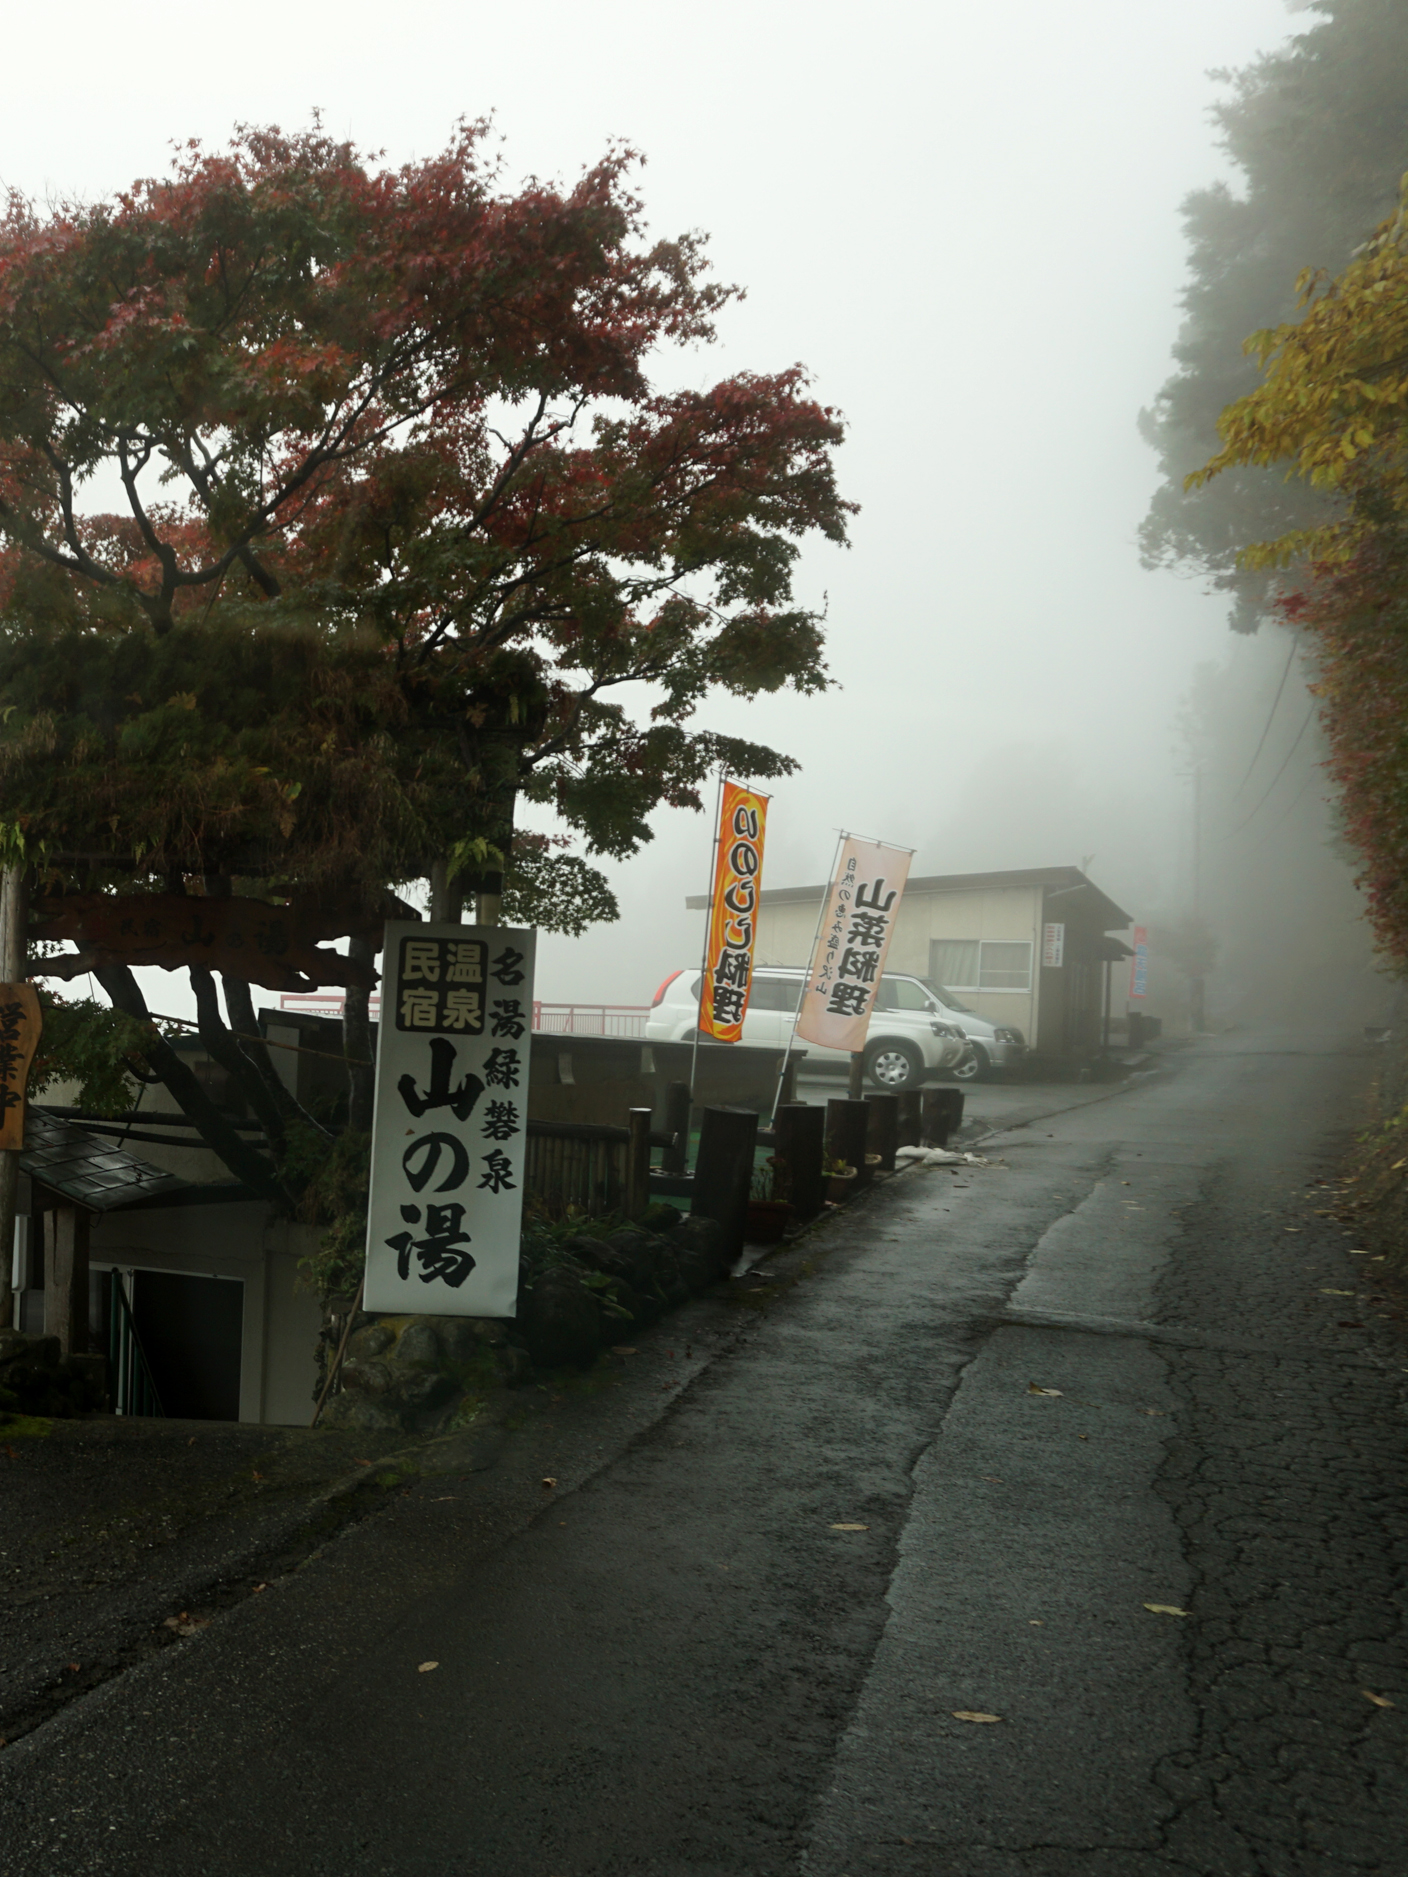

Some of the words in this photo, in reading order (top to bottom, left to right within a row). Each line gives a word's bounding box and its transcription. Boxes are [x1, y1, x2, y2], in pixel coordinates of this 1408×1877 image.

[399, 941, 442, 1029] 民宿
[441, 942, 484, 1030] 温泉
[384, 1037, 485, 1289] 山の湯
